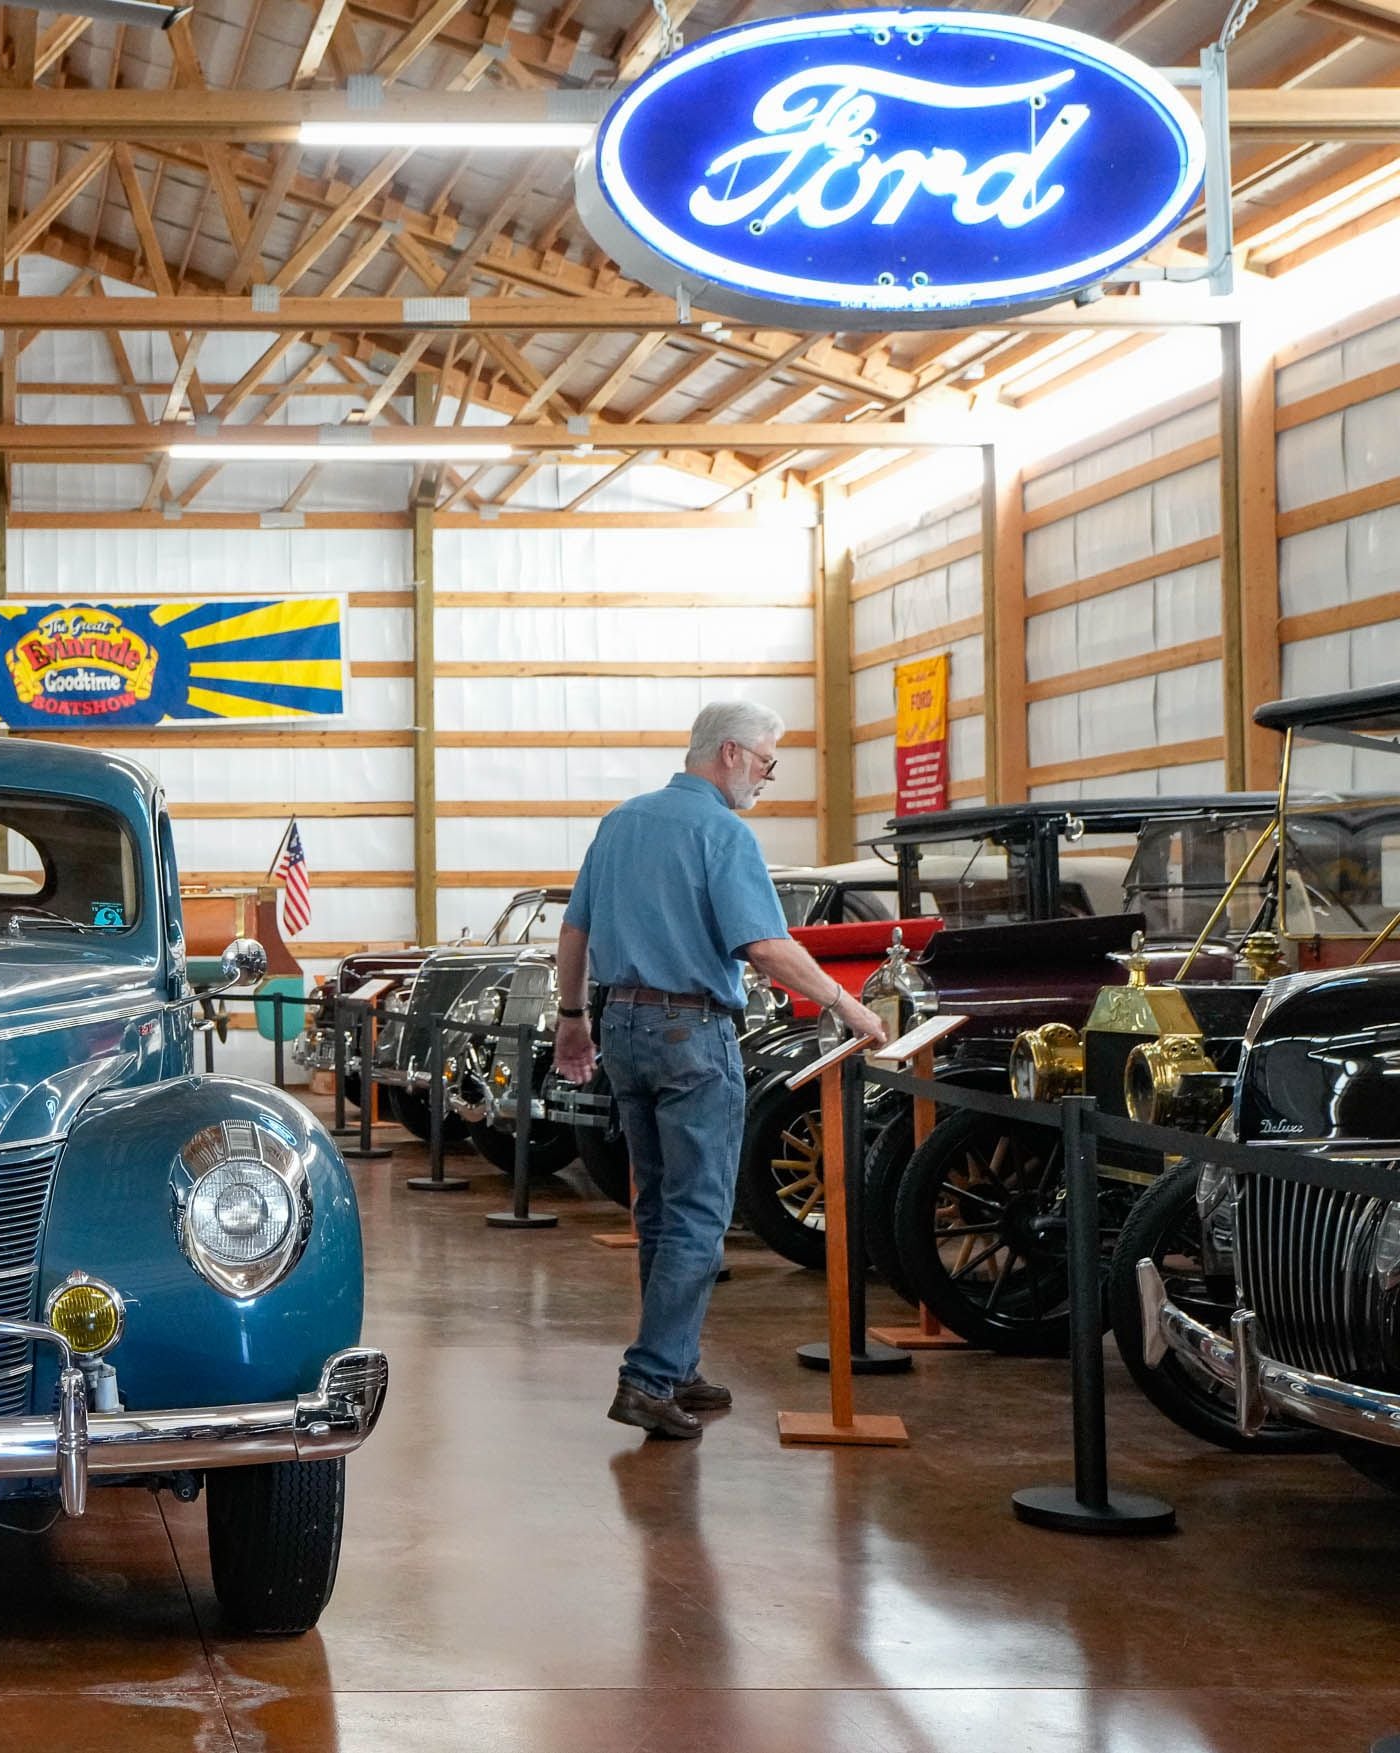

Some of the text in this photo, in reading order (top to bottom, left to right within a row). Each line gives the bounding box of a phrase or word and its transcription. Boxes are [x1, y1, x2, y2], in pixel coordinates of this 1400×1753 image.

[688, 62, 1091, 230] Ford
[44, 616, 111, 637] The Great
[21, 634, 141, 670] Evinrude
[44, 668, 122, 693] Goodtime
[31, 691, 137, 715] BOATSHOW
